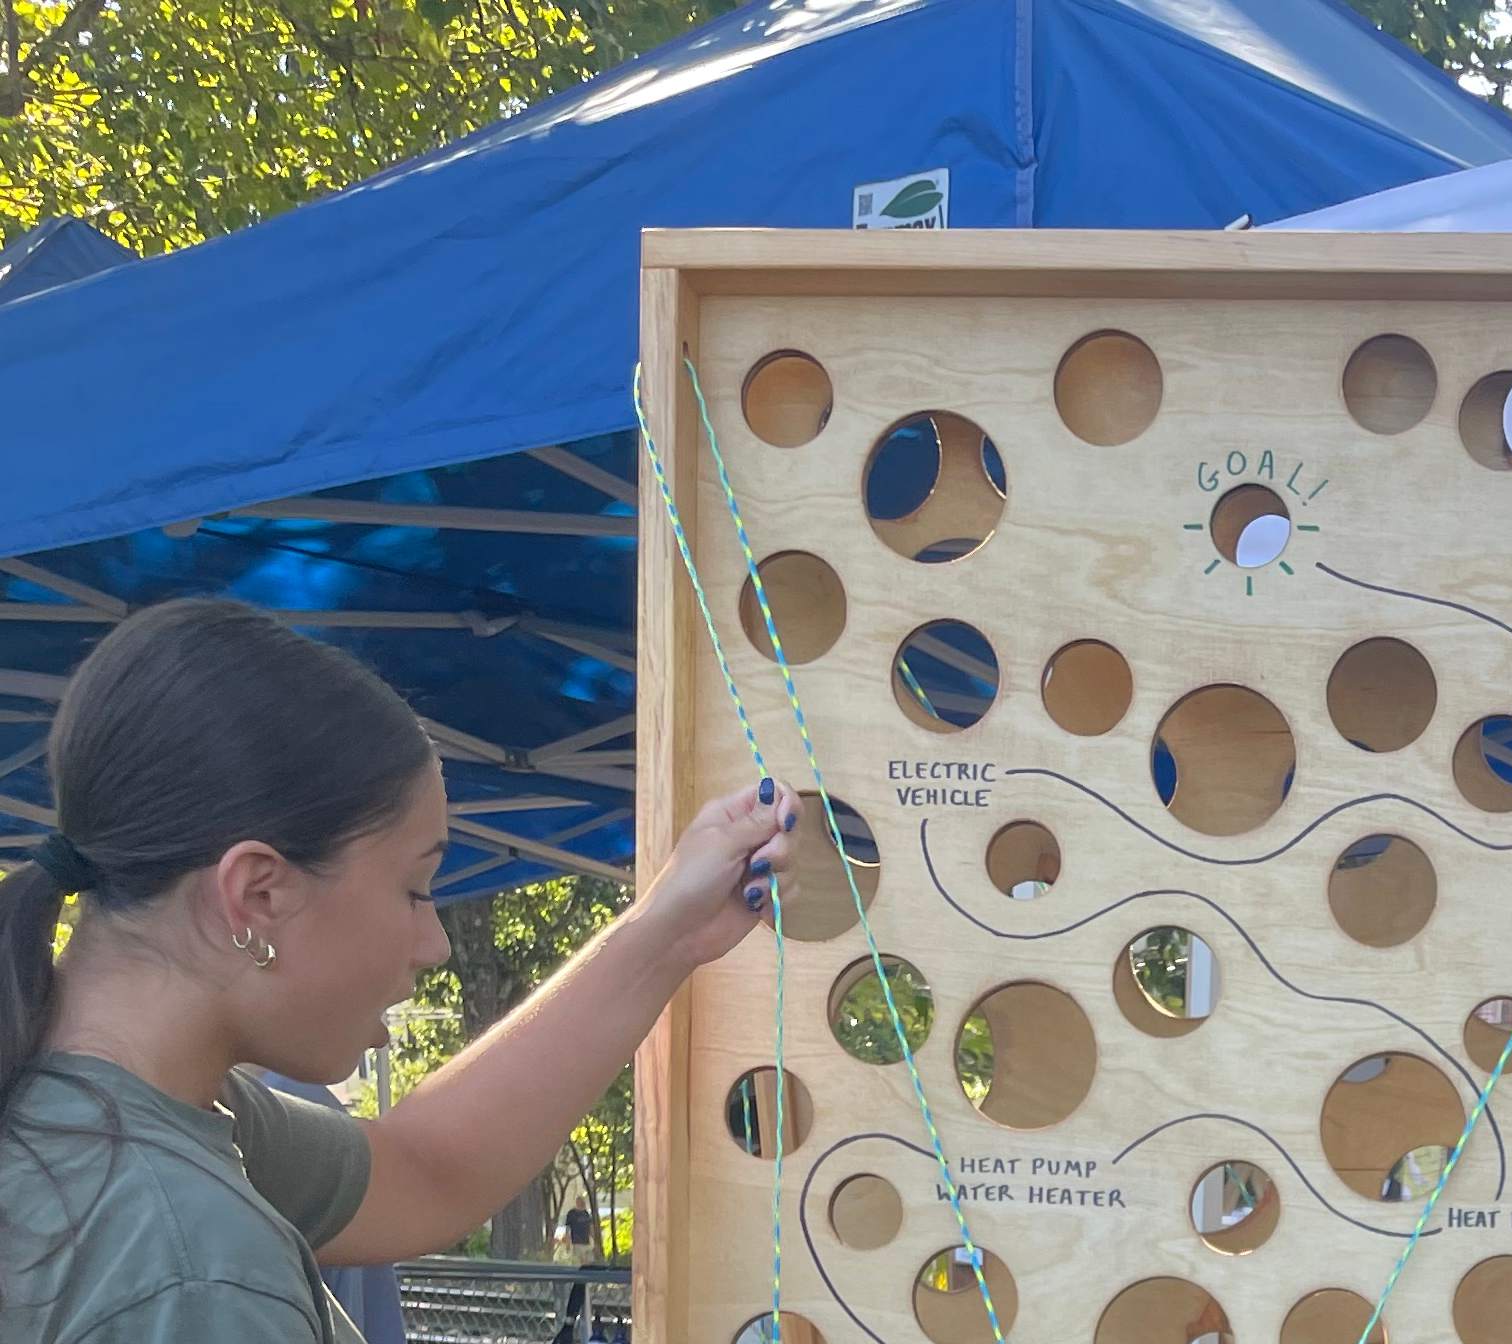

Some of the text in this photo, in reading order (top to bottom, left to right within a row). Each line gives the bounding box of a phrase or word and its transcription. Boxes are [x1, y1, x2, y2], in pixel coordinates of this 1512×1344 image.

[1198, 450, 1329, 506] GOAL!
[888, 760, 997, 783] ELECTRIC
[896, 787, 992, 807] VEHICLE
[960, 1156, 1097, 1178] HEAT PUMP
[936, 1183, 1126, 1208] WATER HEATER
[1448, 1207, 1500, 1228] HEAT
